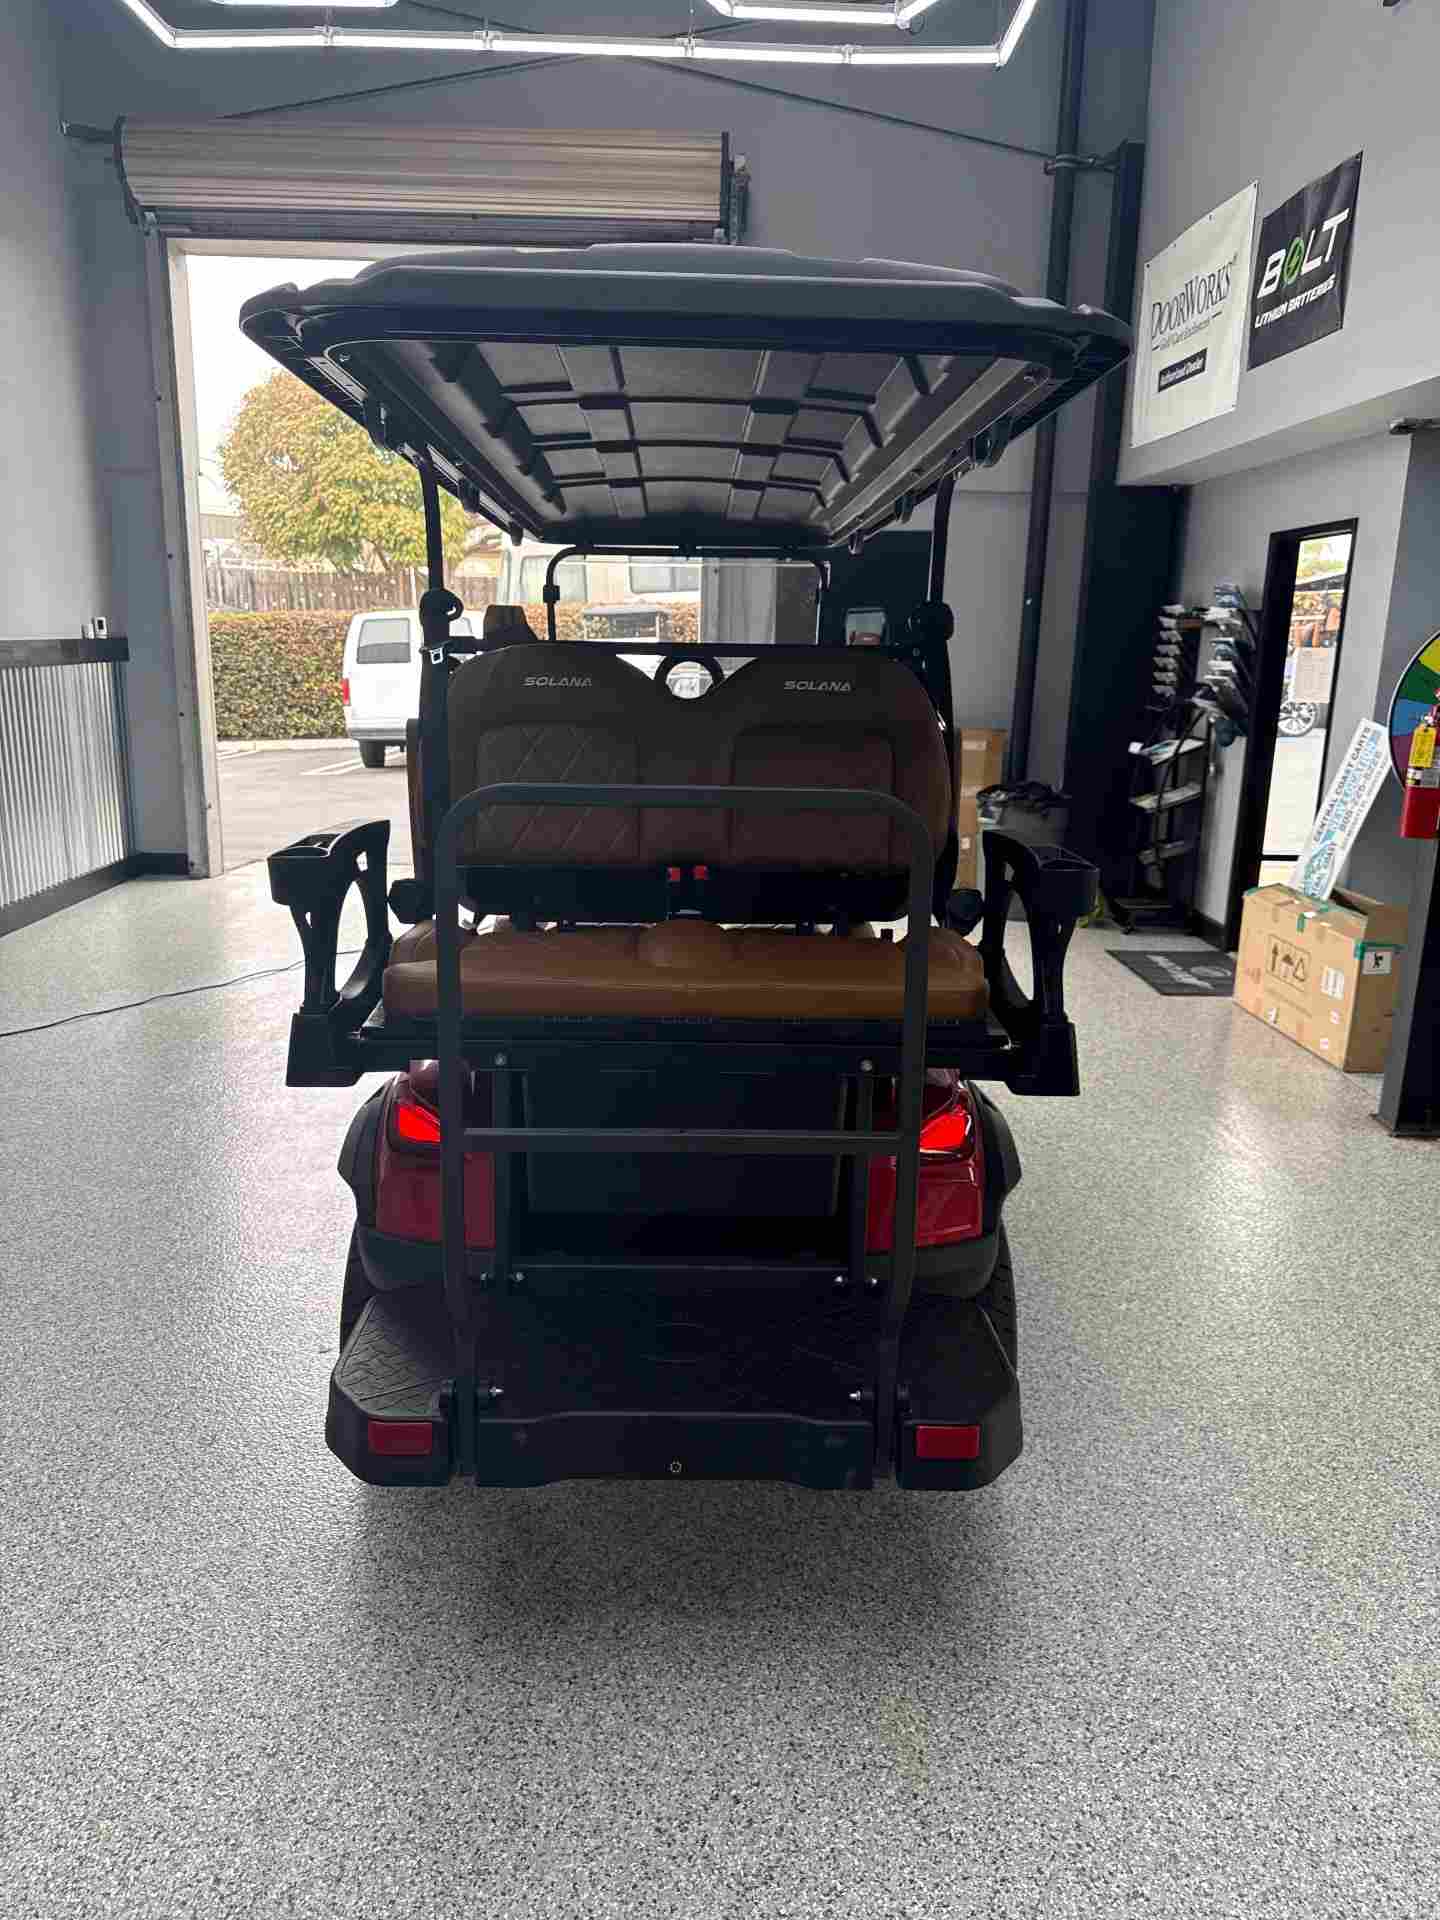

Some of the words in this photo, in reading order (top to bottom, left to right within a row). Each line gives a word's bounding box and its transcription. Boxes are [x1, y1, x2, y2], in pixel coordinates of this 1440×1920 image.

[1257, 208, 1350, 298] BOLT
[1287, 273, 1336, 313] BATTERIES
[523, 676, 593, 687] SOLANA
[783, 680, 851, 692] SOLANA
[1313, 796, 1338, 842] CENTRAL
[1350, 726, 1371, 761] CARTS
